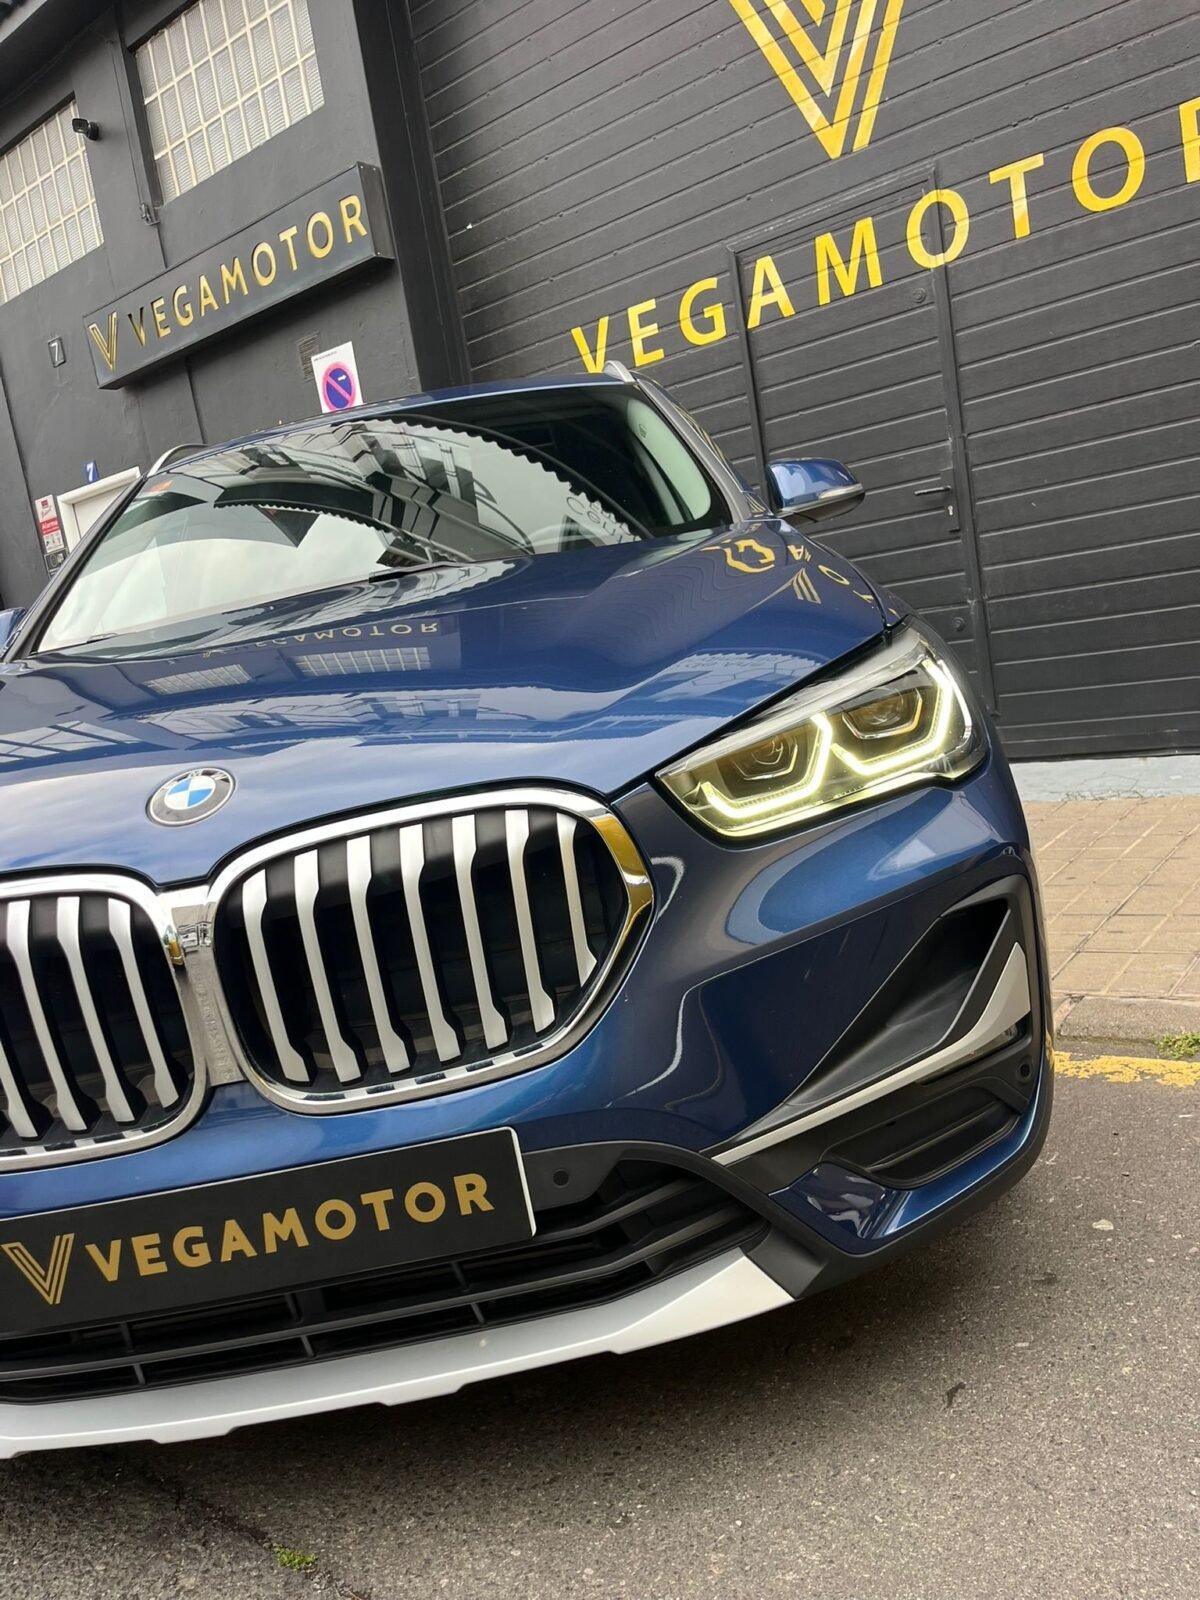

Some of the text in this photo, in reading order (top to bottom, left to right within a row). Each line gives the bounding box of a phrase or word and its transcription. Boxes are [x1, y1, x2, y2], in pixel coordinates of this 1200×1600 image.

[127, 193, 369, 347] VEGAMOTOR
[49, 341, 59, 363] 7
[86, 461, 95, 482] 7
[85, 1172, 495, 1282] VEGAMOTOR
